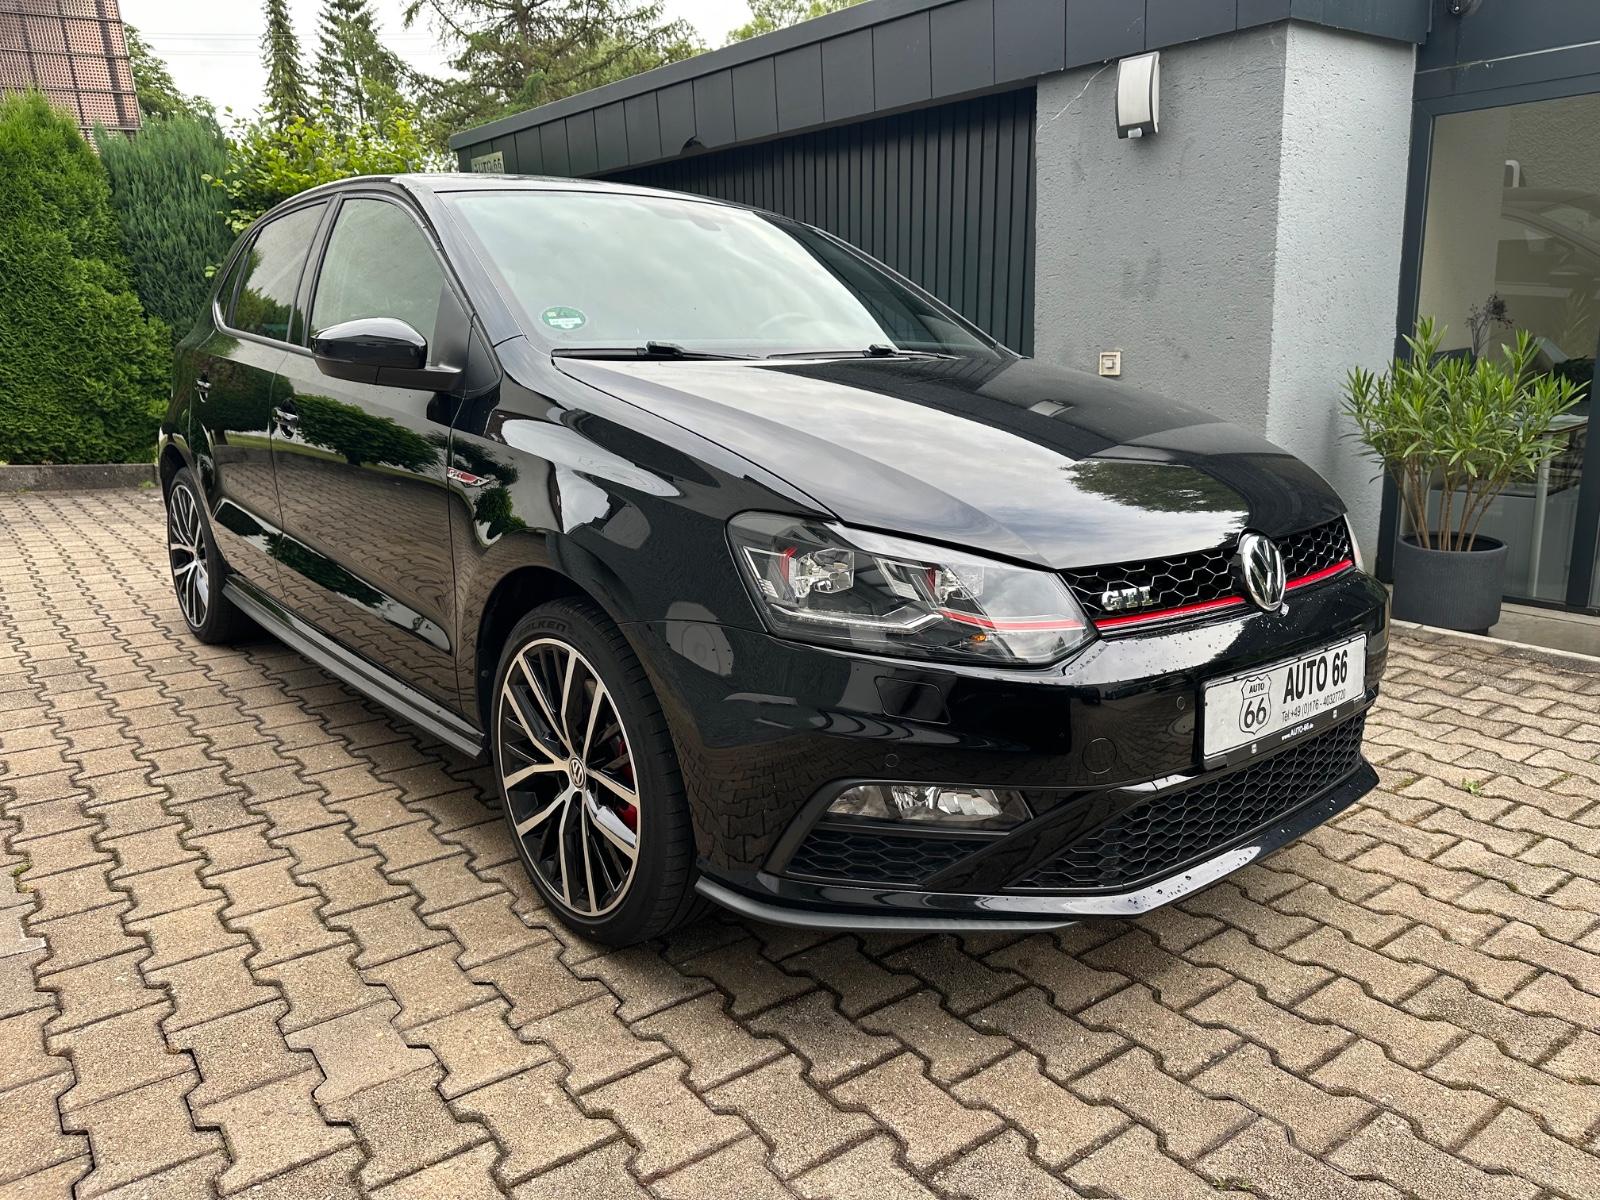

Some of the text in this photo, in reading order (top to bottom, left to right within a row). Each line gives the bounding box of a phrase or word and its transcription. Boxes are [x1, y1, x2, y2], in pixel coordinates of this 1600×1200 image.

[474, 158, 502, 173] AUTO 66
[1101, 585, 1153, 611] GTI
[1249, 683, 1264, 693] AUTO
[1283, 650, 1347, 704] AUTO 66
[1244, 697, 1266, 728] 66
